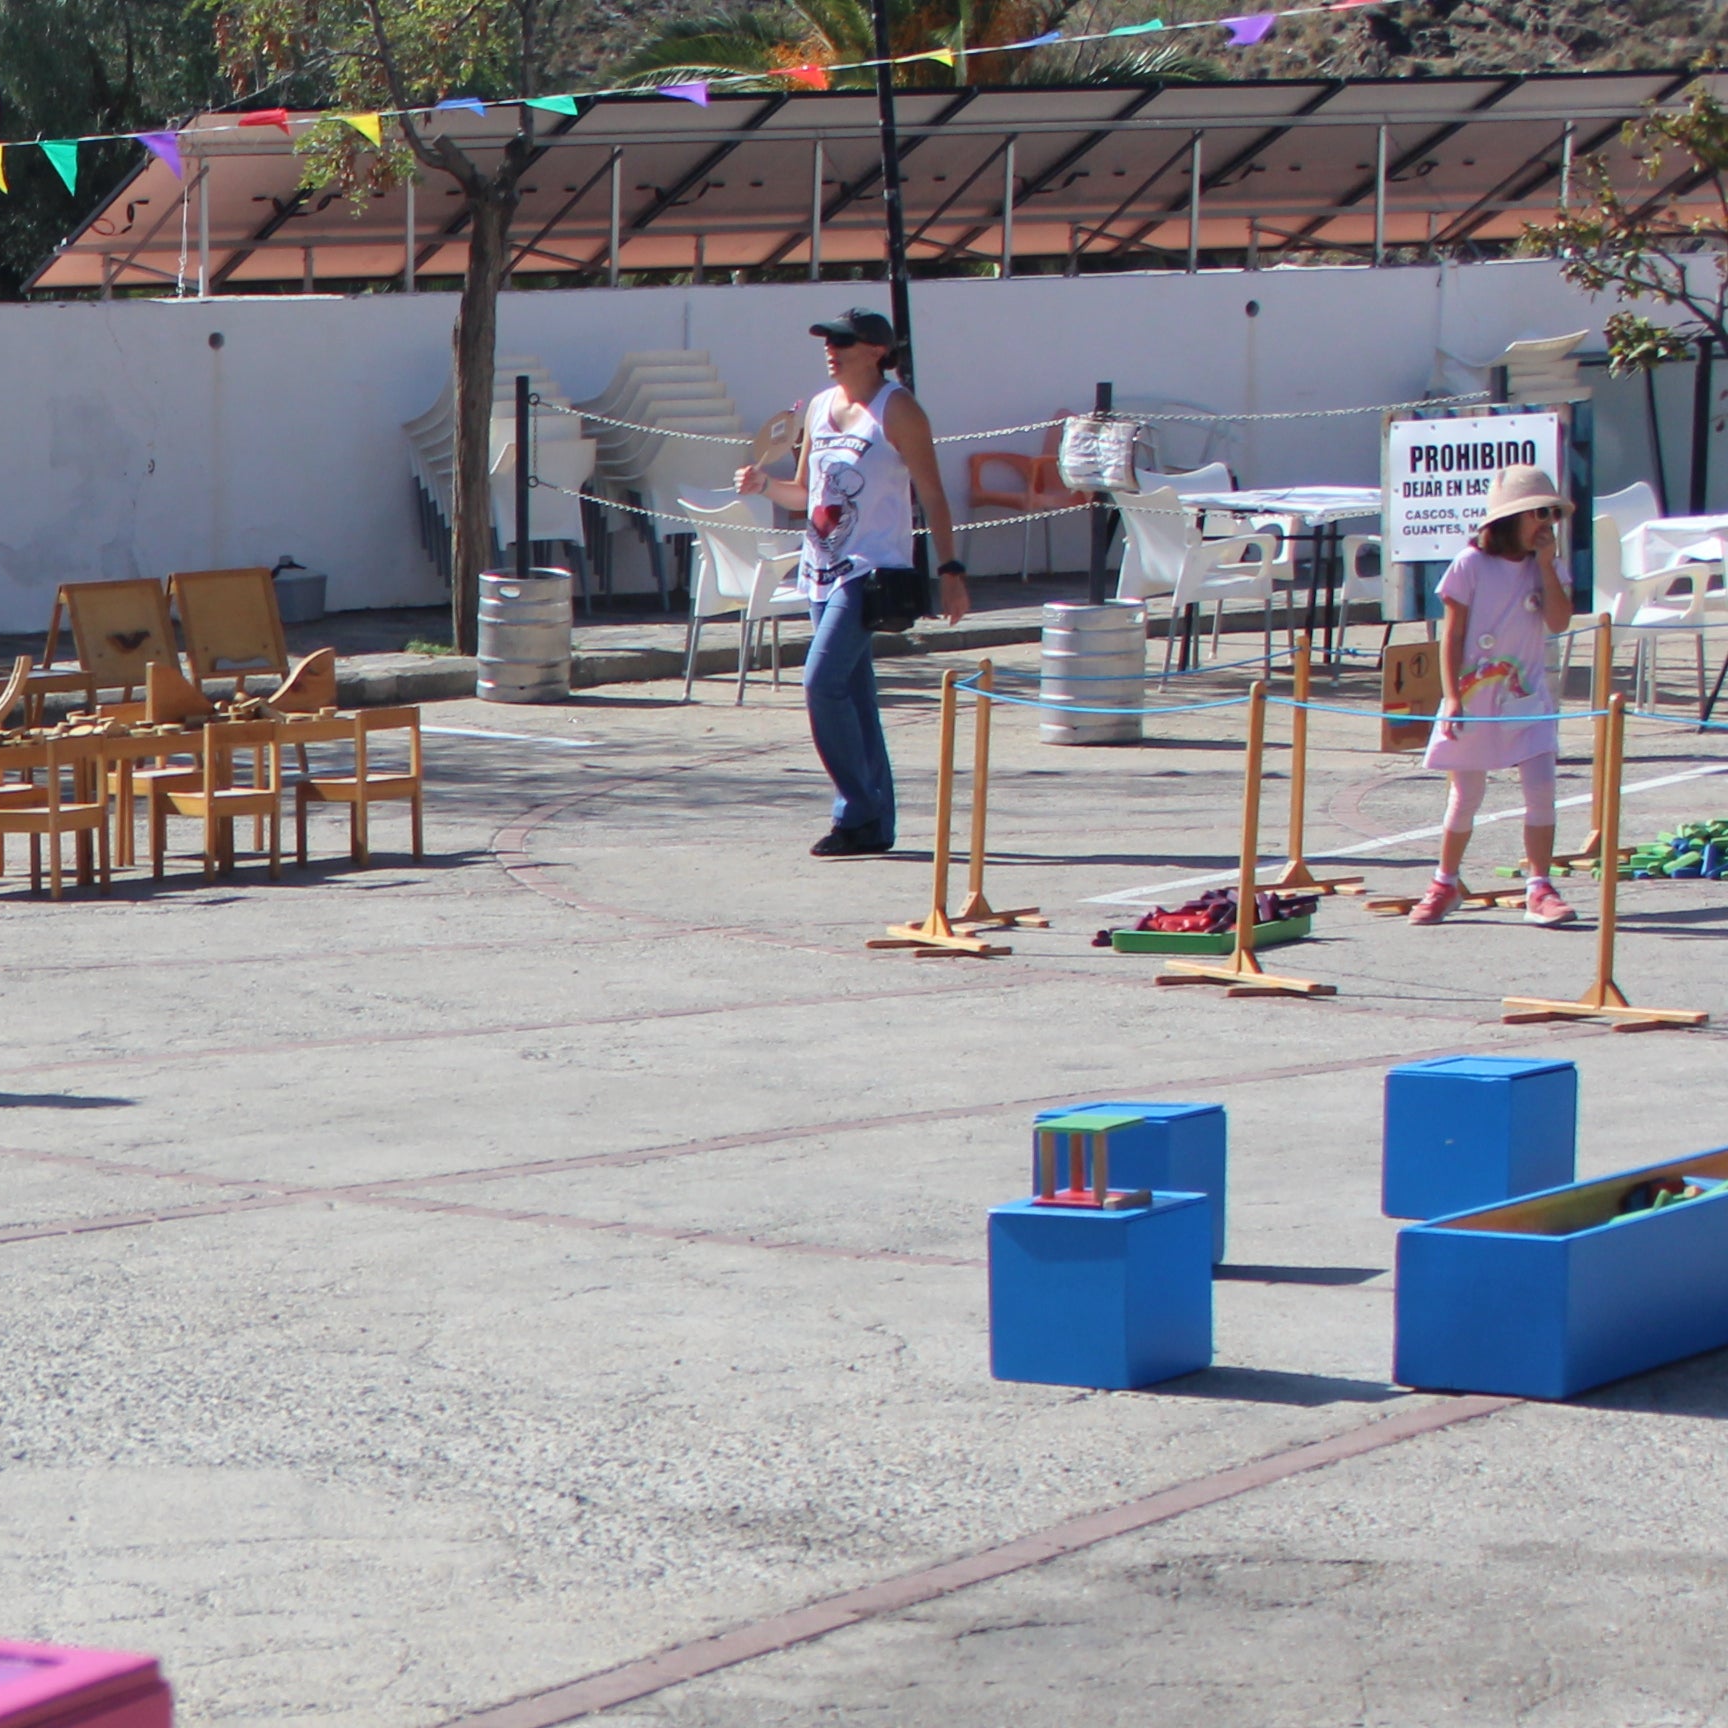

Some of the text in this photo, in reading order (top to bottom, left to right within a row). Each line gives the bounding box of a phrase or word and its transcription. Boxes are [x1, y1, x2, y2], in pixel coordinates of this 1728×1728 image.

[1409, 440, 1536, 473] PROHIBIDO
[1403, 480, 1442, 498] DEJAR
[1446, 479, 1462, 496] EN
[1405, 509, 1458, 520] CASCOS,
[1403, 524, 1465, 536] GUANTES,
